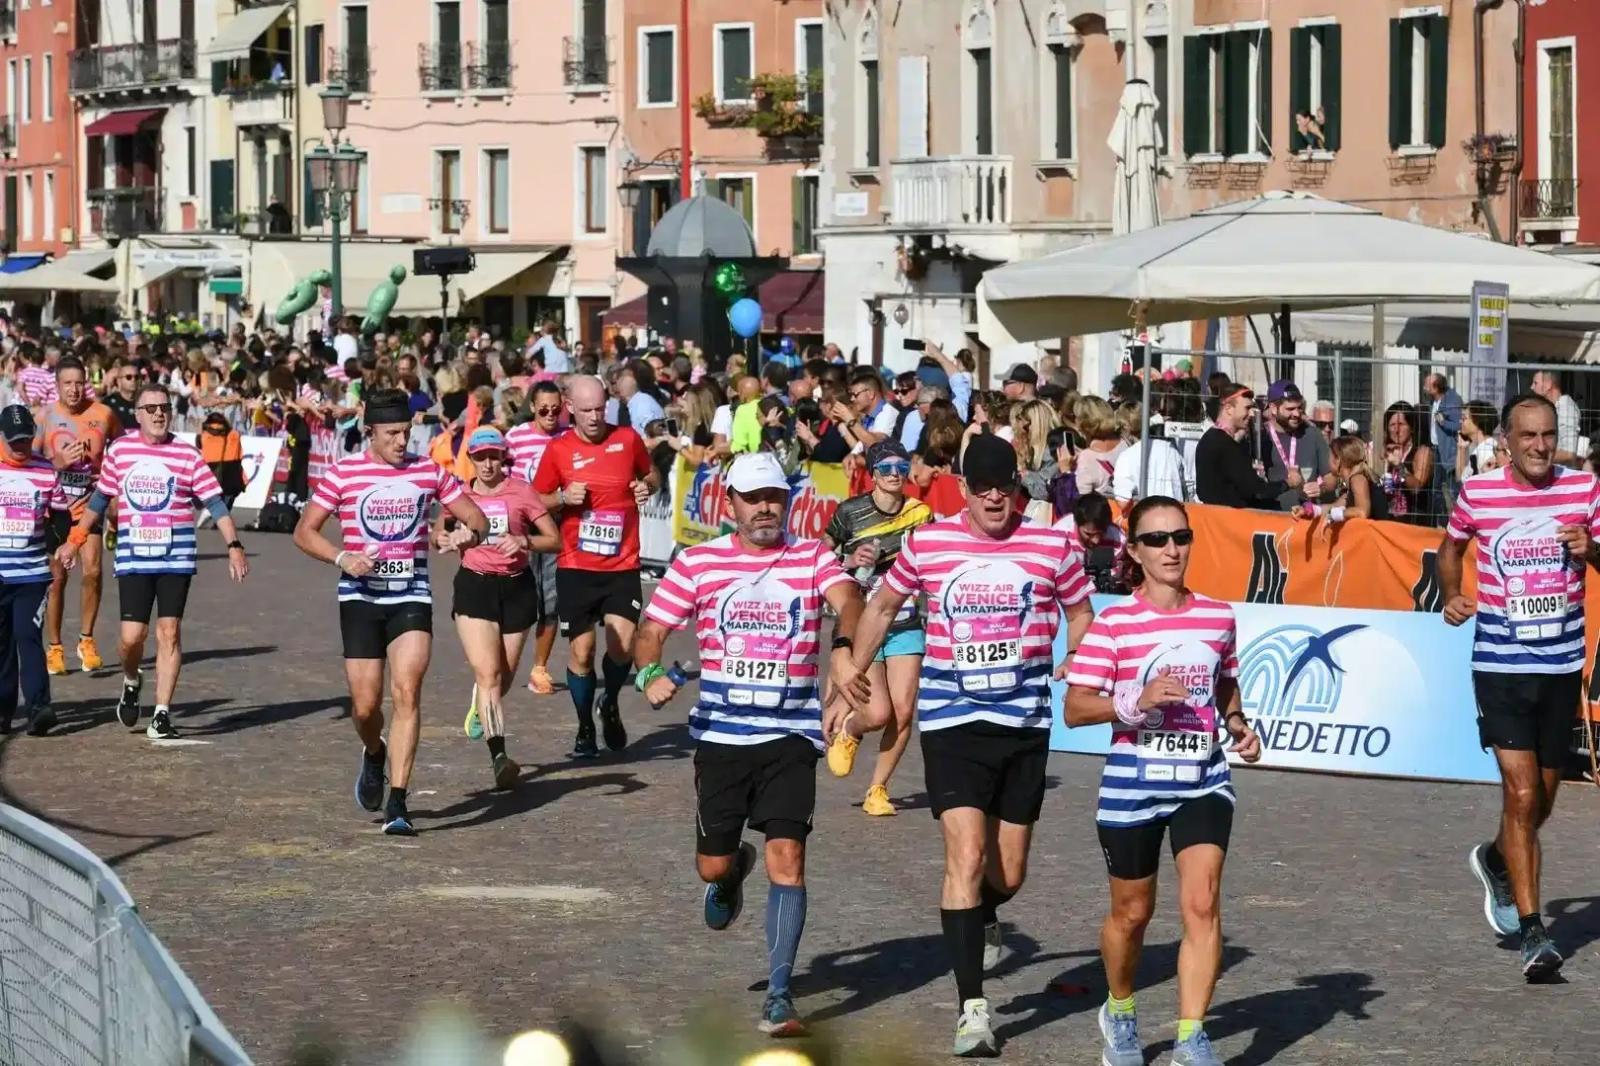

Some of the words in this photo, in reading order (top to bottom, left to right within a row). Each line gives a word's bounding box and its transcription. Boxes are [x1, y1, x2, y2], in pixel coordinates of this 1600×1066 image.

[129, 481, 166, 490] VENICE
[368, 504, 415, 514] VENICE
[366, 513, 414, 521] MARATHON
[589, 525, 615, 539] 7816
[1505, 538, 1534, 547] WIZZ
[1537, 538, 1554, 546] AIR
[1501, 546, 1560, 559] VENICE
[374, 561, 404, 574] 9363
[1502, 557, 1560, 567] MARATHON
[959, 584, 990, 592] WIZZ
[994, 584, 1014, 592] AIR
[954, 594, 1018, 605] VENICE
[732, 601, 762, 610] WIZZ
[764, 602, 782, 611] AIR
[952, 605, 1018, 614] MARATHON
[1520, 598, 1557, 616] 10009
[728, 610, 787, 624] VENICE
[726, 621, 787, 632] MARATHON
[966, 642, 1008, 664] 8125
[735, 660, 776, 680] 8127
[1189, 664, 1208, 674] AIR
[1155, 733, 1199, 753] 7644
